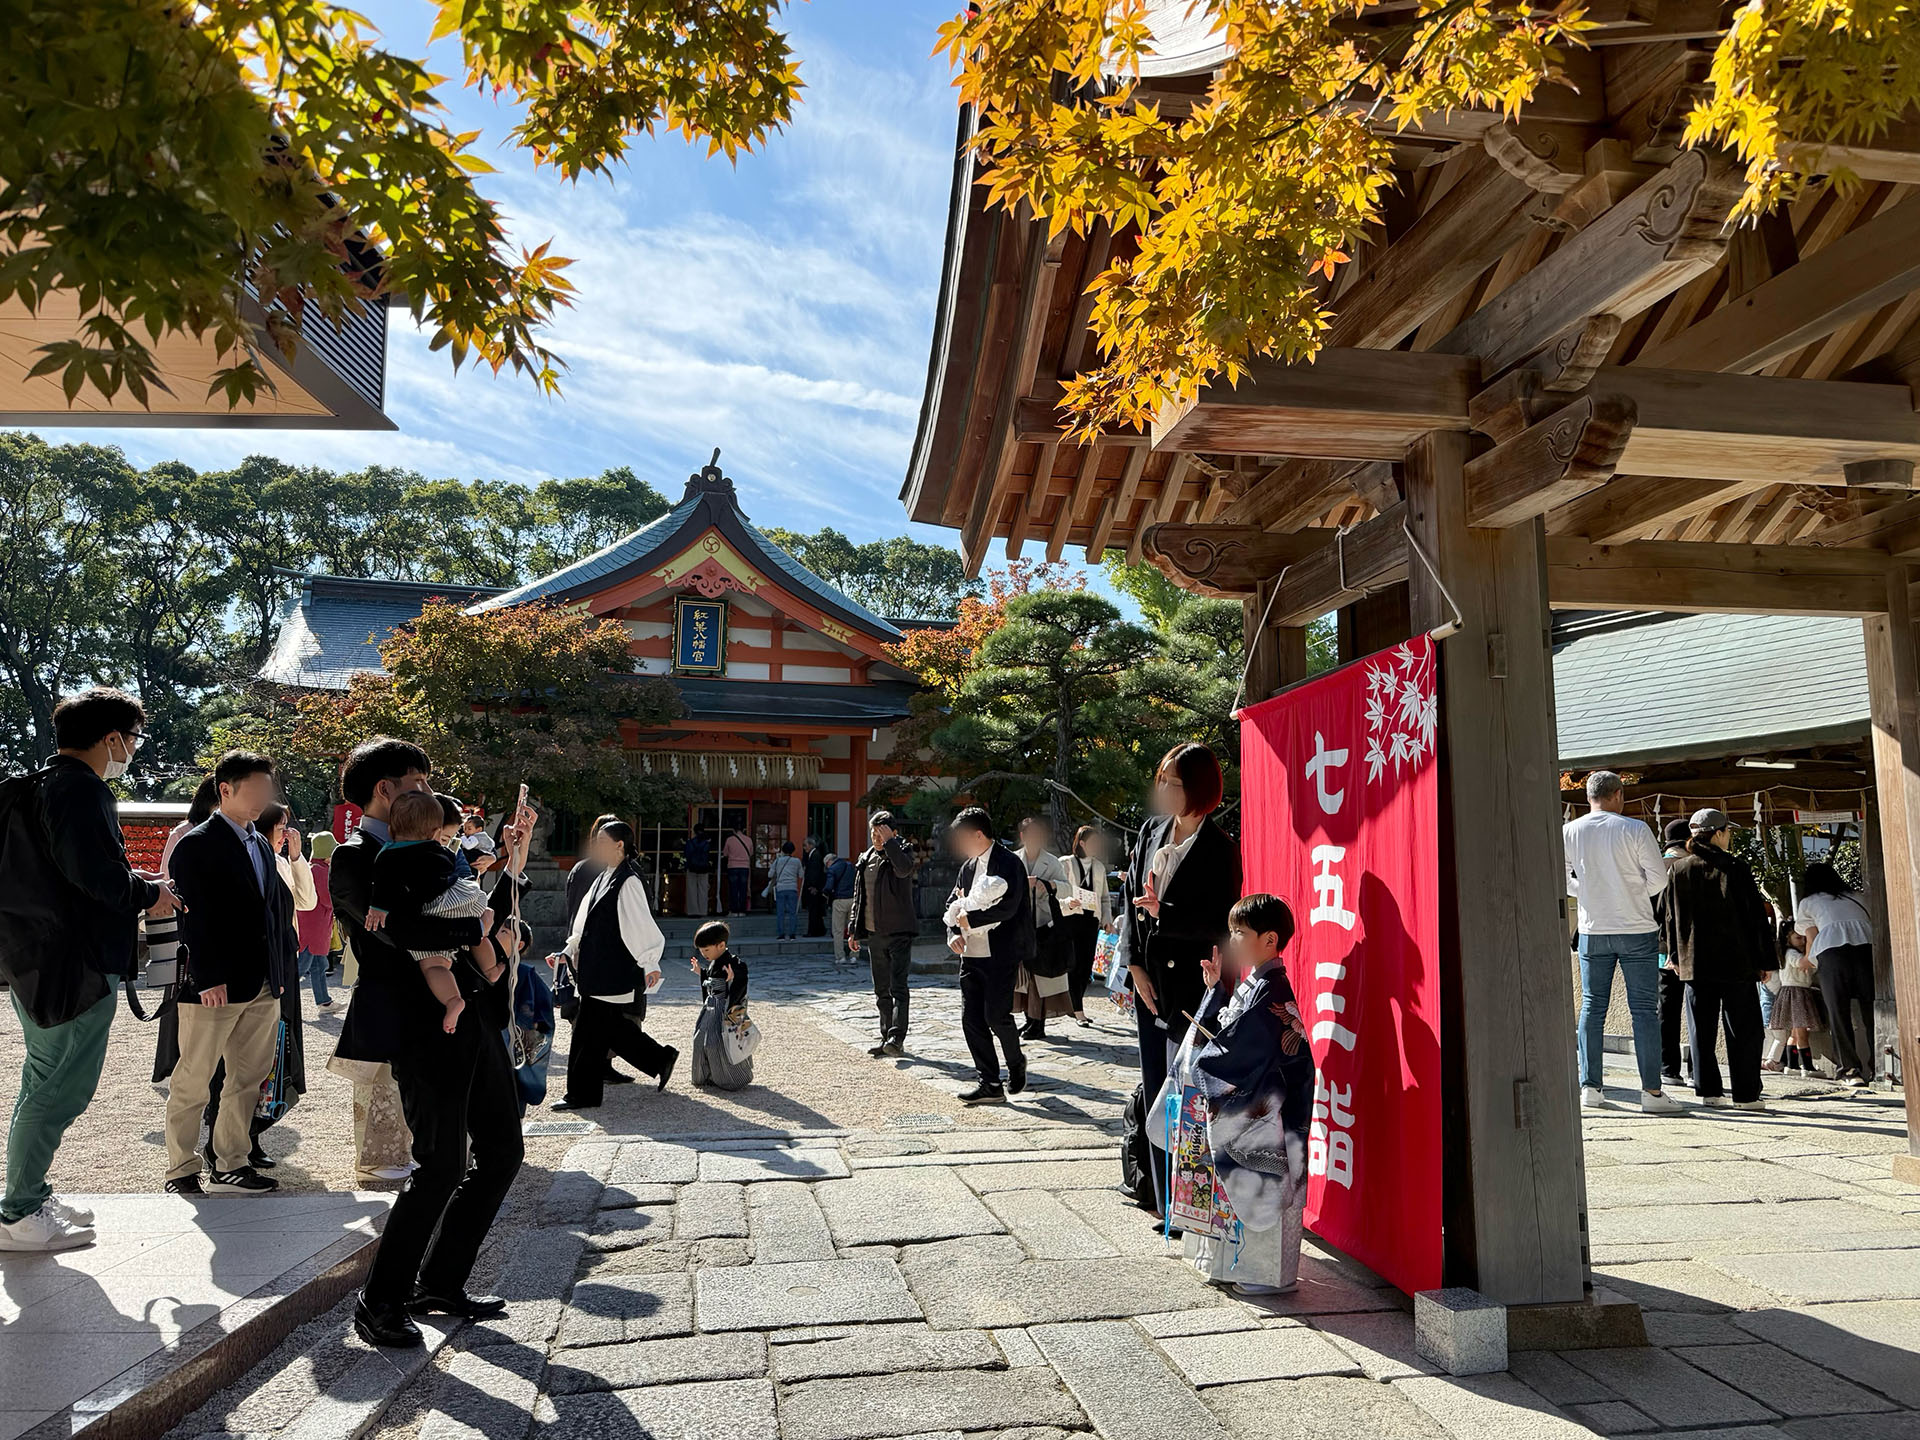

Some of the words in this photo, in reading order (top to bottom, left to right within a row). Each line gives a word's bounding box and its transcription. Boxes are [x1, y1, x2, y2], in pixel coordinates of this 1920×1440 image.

[693, 609, 709, 663] 紅葉八幡宮
[1306, 731, 1357, 1190] 七五三詣
